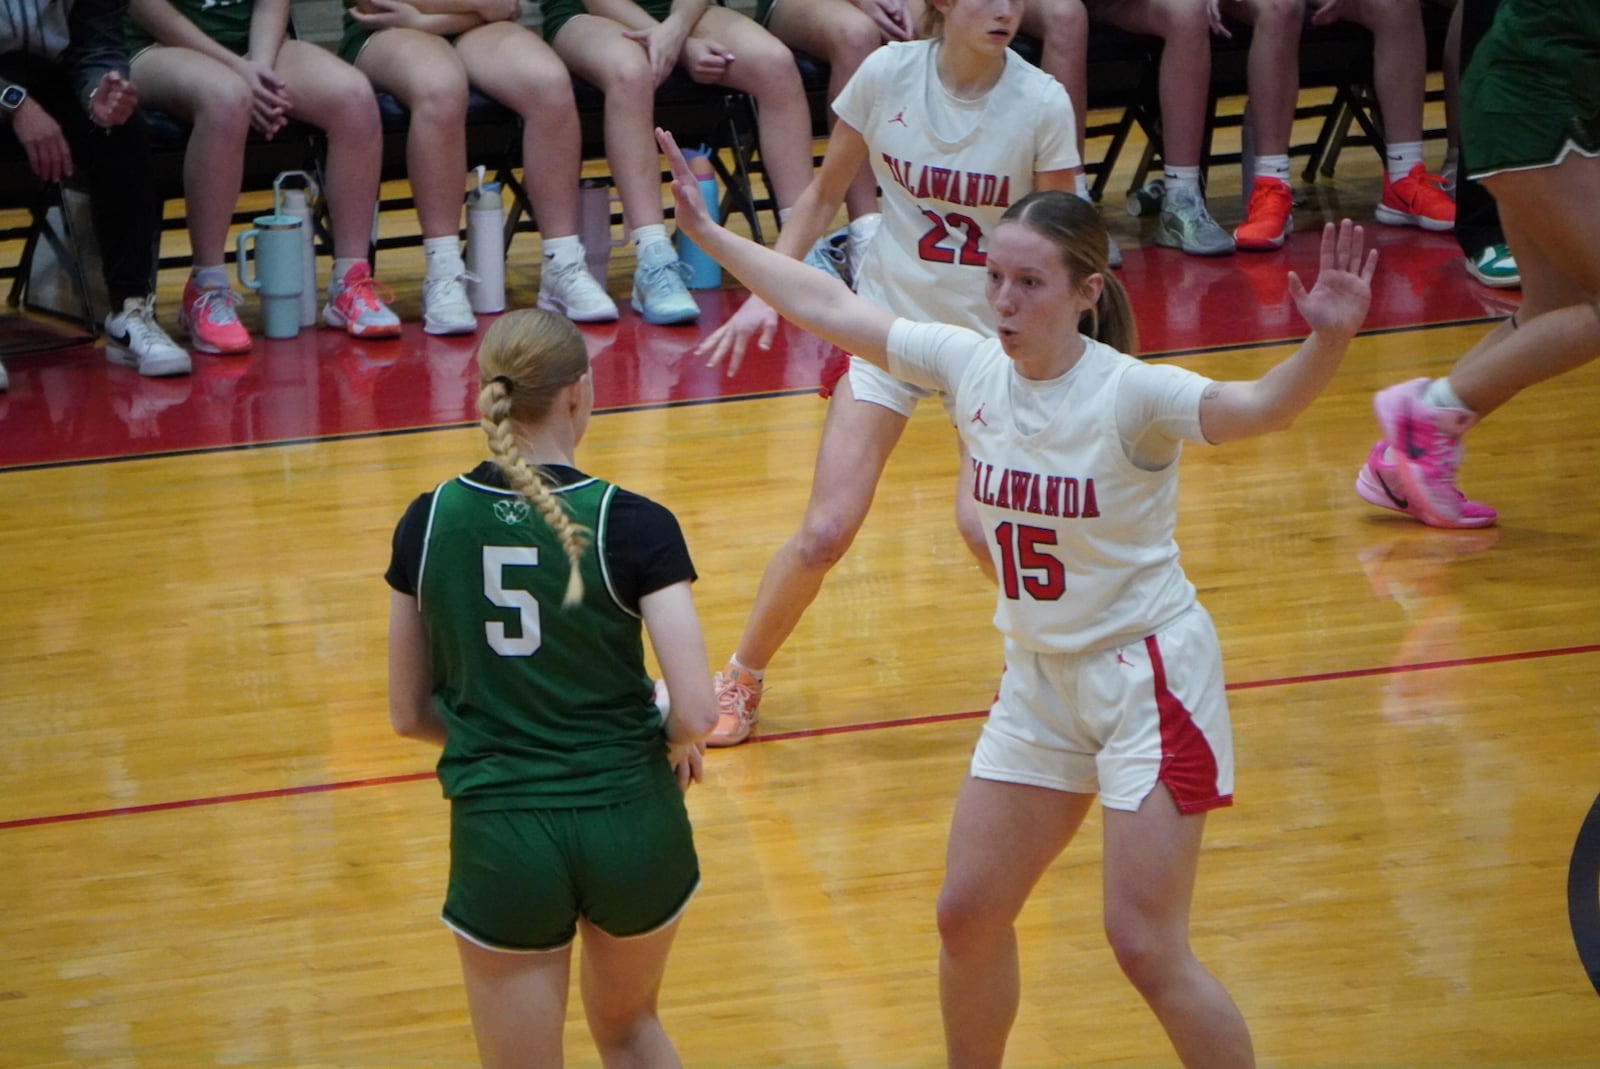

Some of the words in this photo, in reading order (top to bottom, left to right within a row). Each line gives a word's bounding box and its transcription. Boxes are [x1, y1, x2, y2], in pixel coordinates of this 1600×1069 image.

[918, 209, 988, 267] 22
[482, 545, 542, 657] 5
[995, 521, 1067, 601] 15
